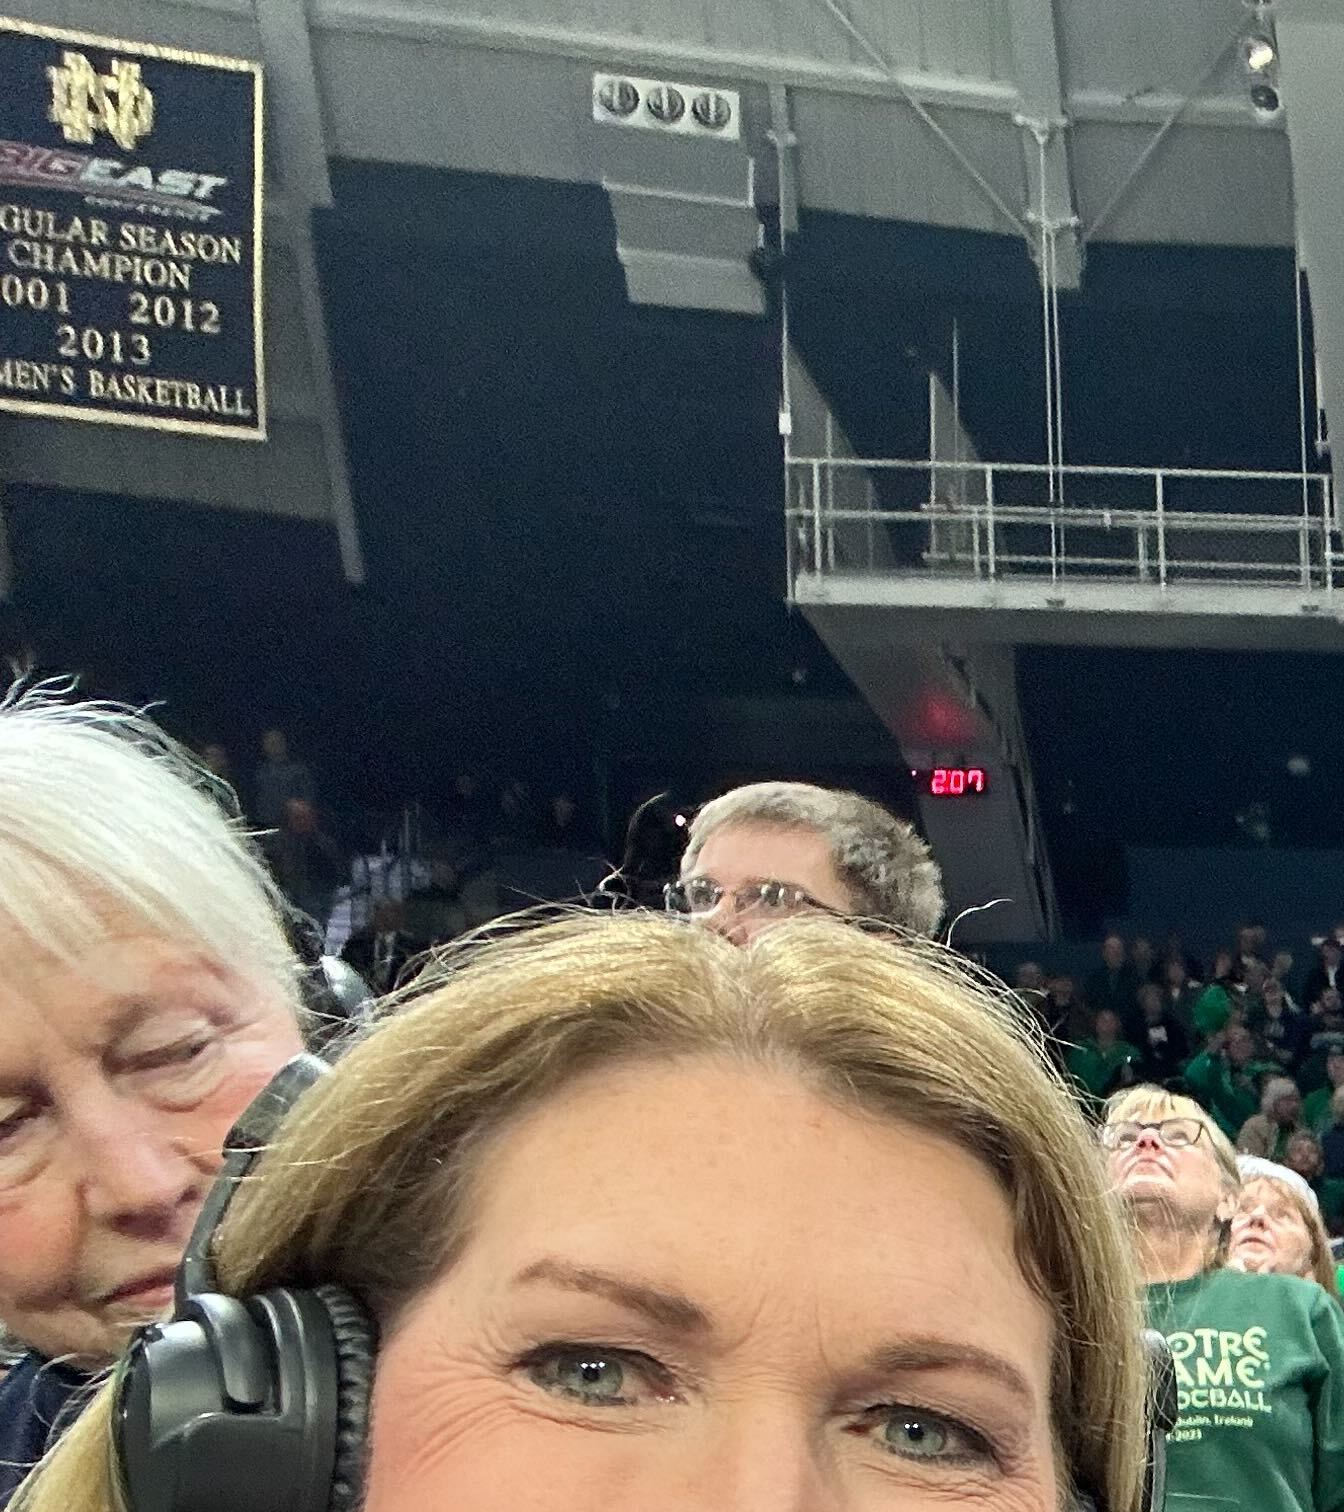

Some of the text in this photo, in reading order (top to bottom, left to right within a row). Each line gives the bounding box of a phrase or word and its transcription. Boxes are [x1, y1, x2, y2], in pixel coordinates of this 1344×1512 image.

[0, 204, 109, 246] GULAR
[119, 222, 242, 265] SEASON
[8, 238, 193, 291] CHAMPION
[1, 274, 221, 335] 001 2012
[57, 324, 151, 365] 2013
[89, 368, 250, 416] BASKETBALL
[1166, 1326, 1269, 1361] OTRE
[1175, 1355, 1265, 1388] AME
